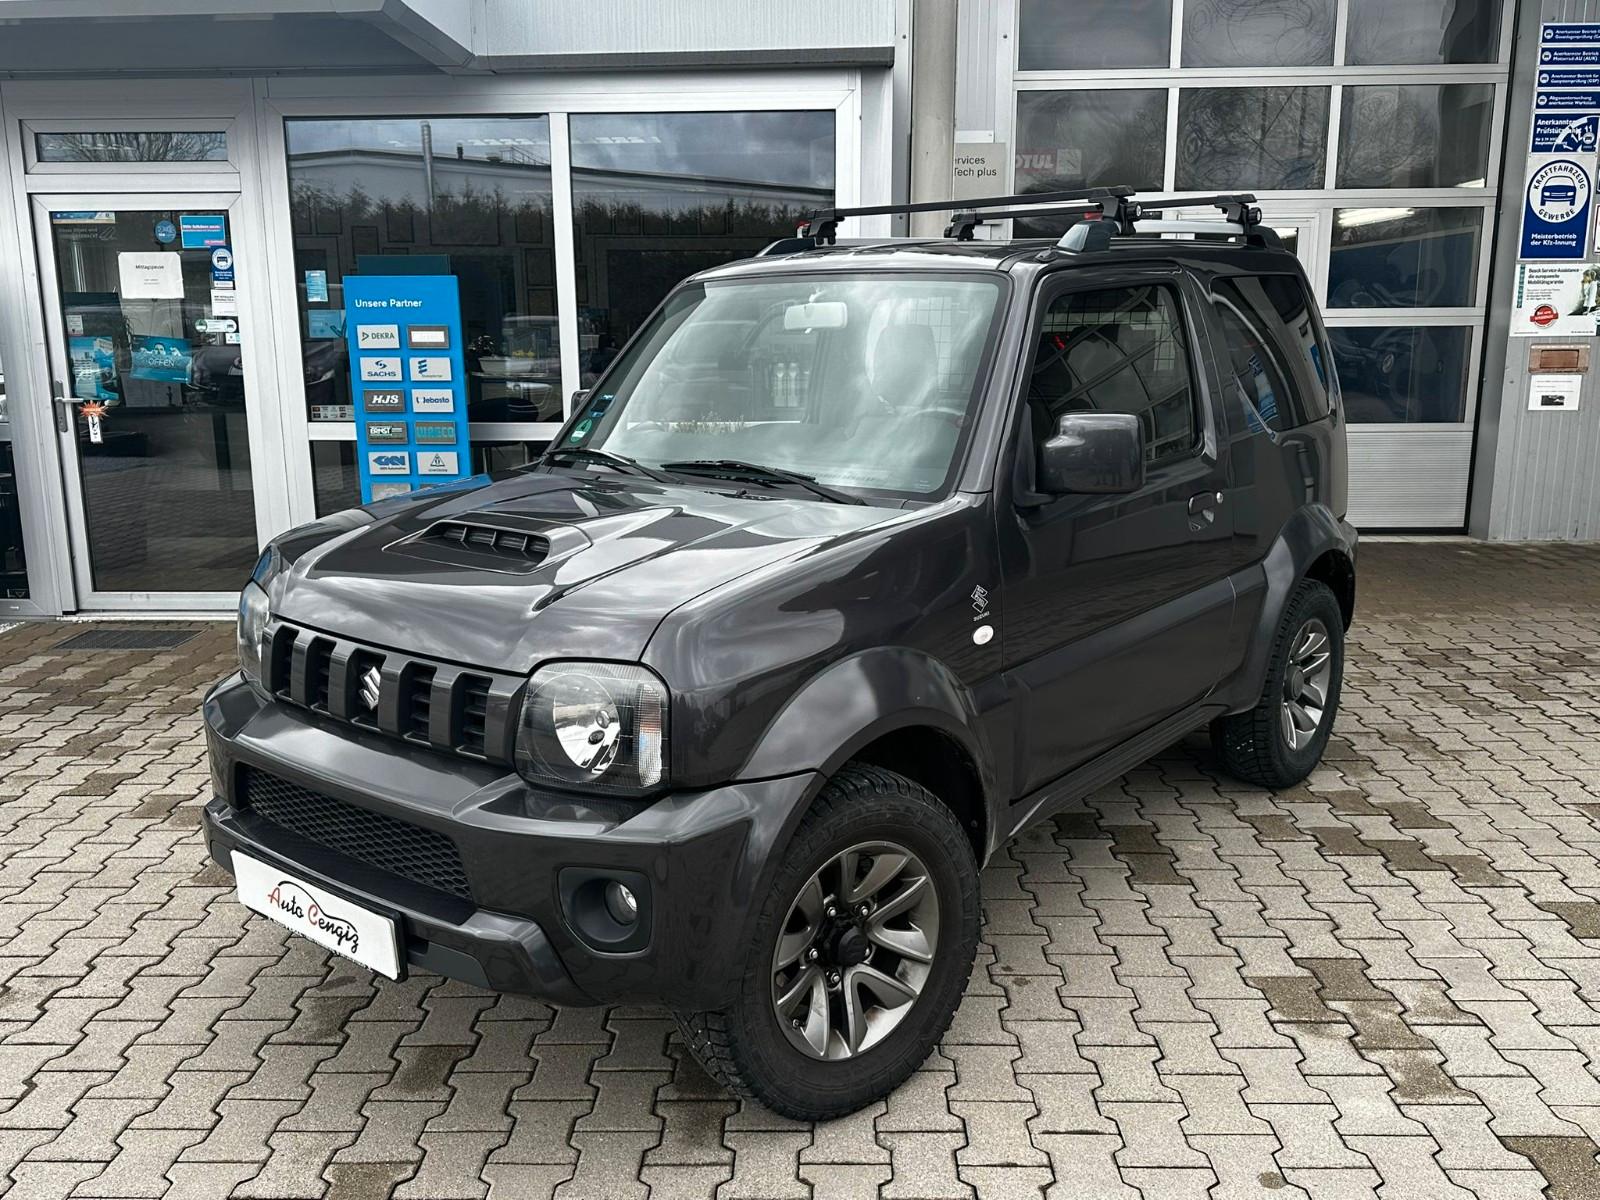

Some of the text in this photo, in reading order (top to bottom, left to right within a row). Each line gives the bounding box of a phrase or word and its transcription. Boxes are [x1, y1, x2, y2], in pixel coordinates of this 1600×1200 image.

[977, 167, 997, 179] plus
[1533, 164, 1586, 190] KRAFTFAHRZEUG
[1538, 208, 1576, 221] GEWERBE
[1543, 239, 1577, 247] Kfz-Innung
[355, 298, 423, 308] Unsere Partner
[371, 332, 395, 340] DEKRA
[148, 357, 175, 368] OFFEN
[371, 394, 400, 405] HJS
[267, 887, 359, 954] Auto Cengiz
